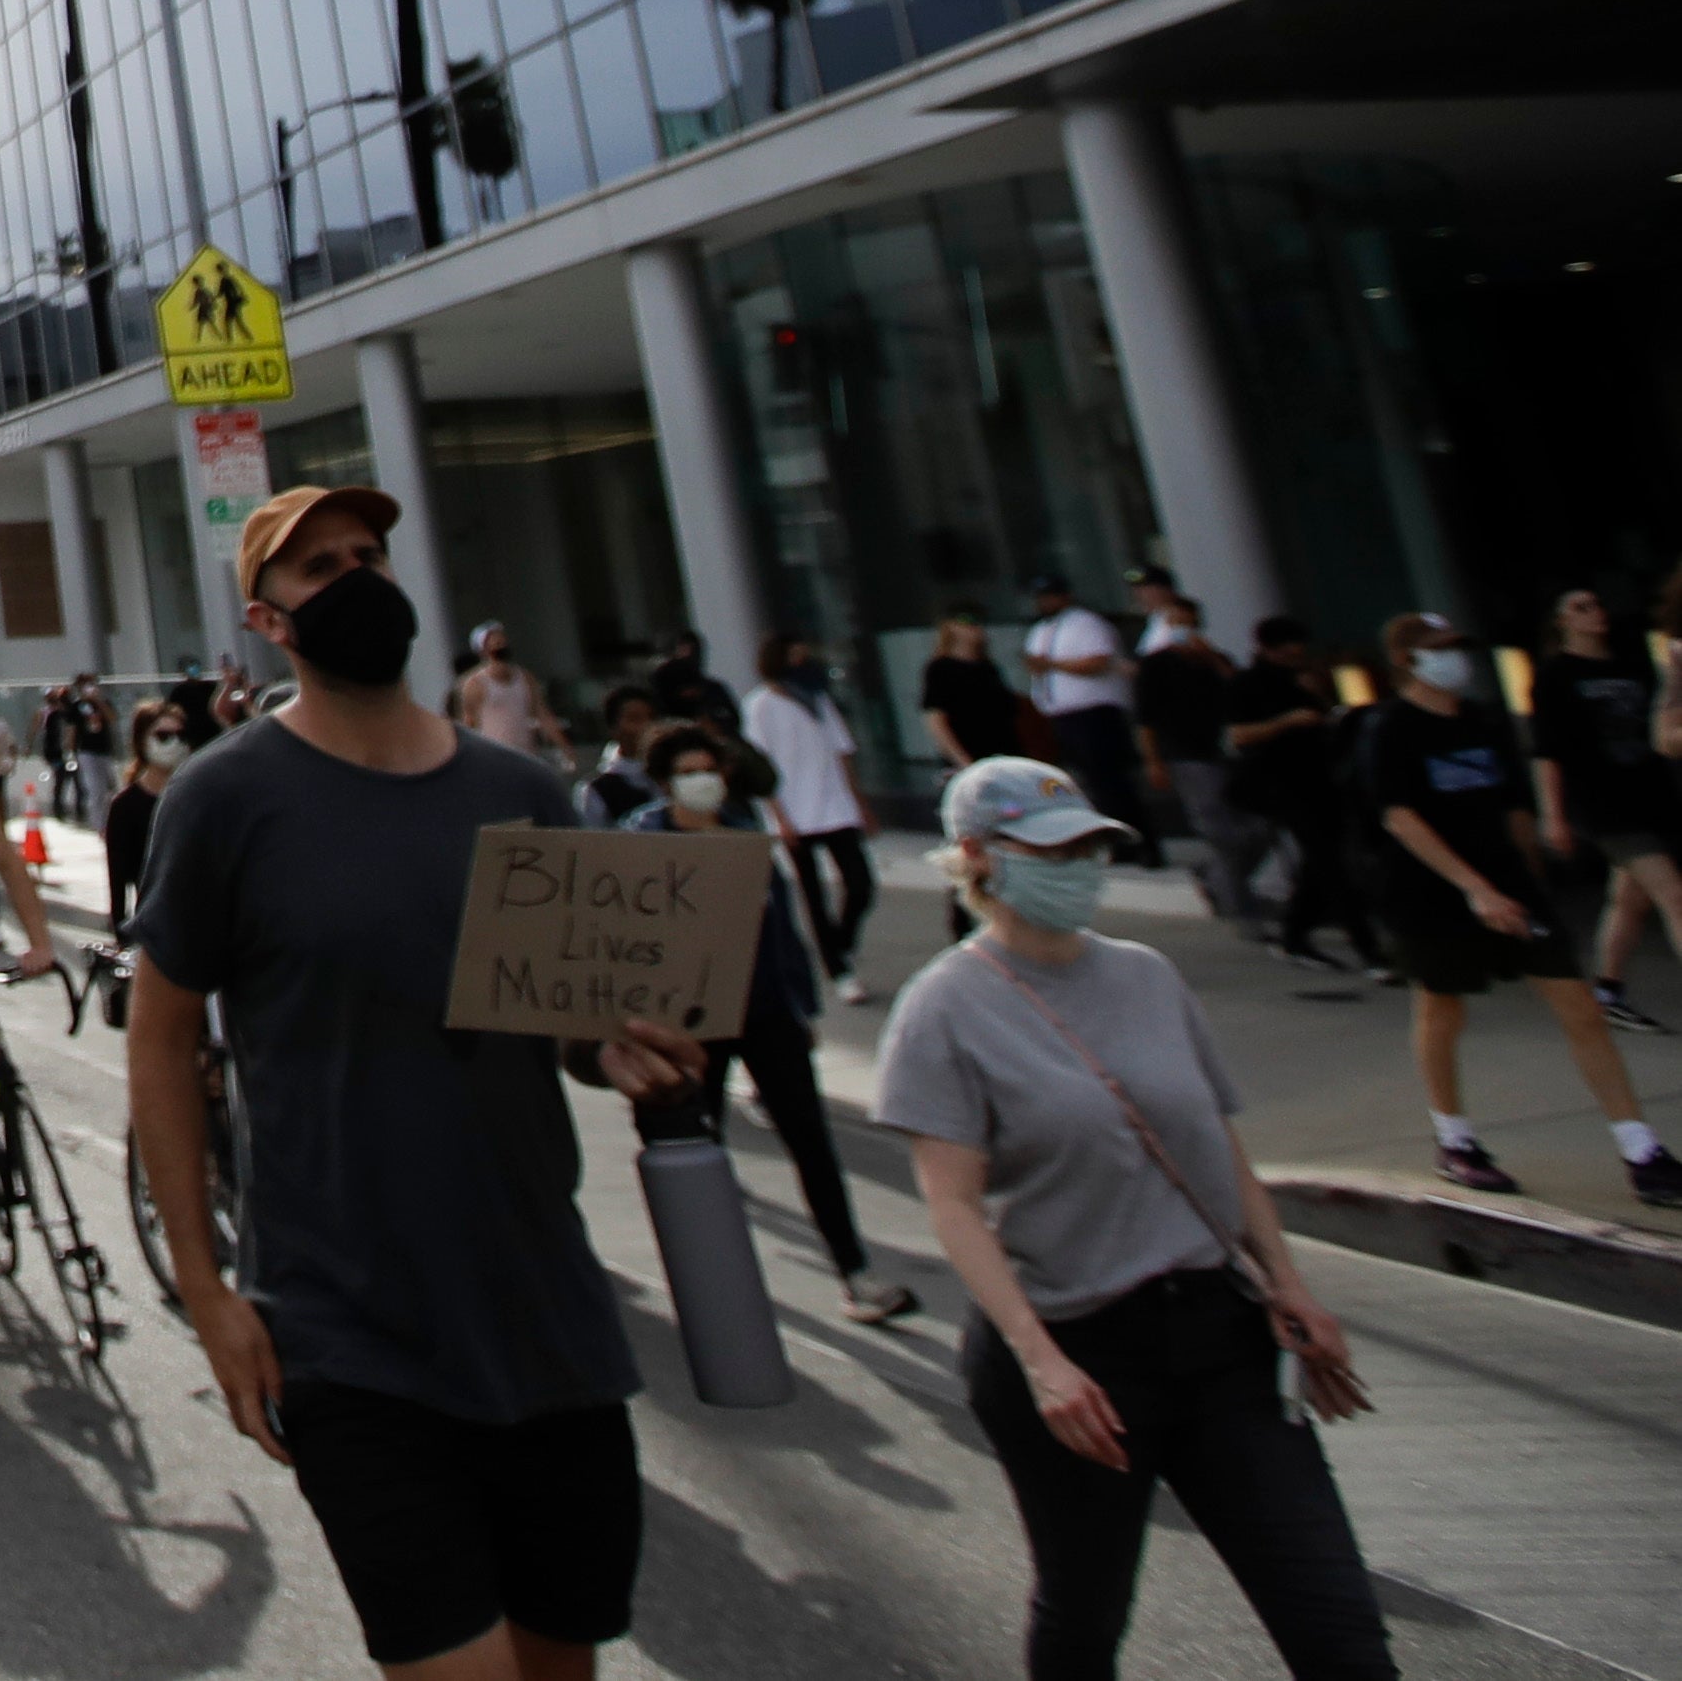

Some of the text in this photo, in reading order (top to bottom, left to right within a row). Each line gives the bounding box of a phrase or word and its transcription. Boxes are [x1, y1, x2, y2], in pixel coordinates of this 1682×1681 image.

[180, 358, 282, 389] AHEAD
[497, 845, 698, 916] Black
[559, 917, 665, 967] Lives
[491, 952, 712, 1029] Matter!
